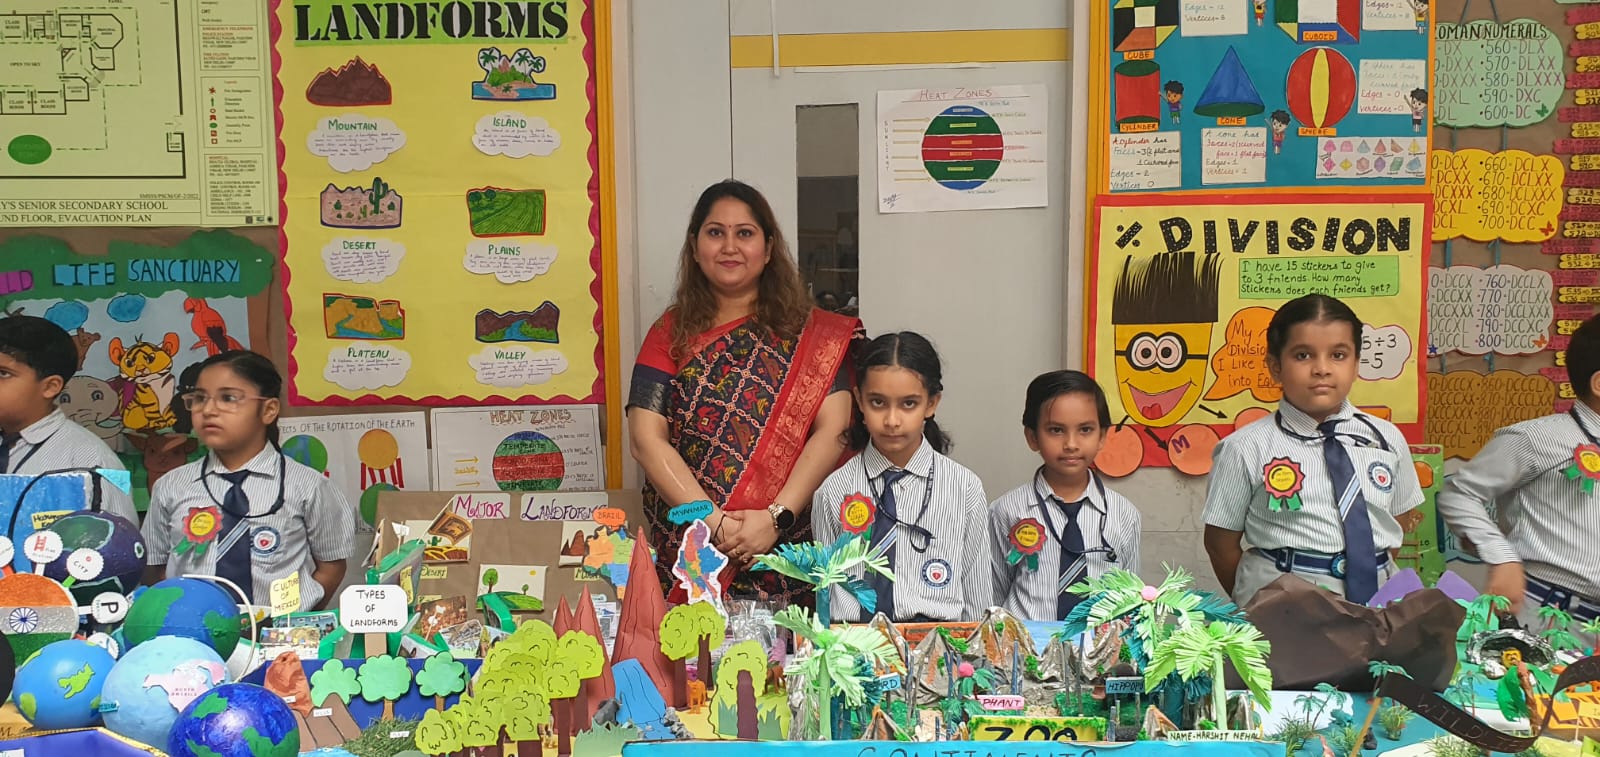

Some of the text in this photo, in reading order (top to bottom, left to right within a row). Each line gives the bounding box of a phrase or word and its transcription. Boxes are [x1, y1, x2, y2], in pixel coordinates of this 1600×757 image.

[294, 0, 568, 41] LANDFORMS
[1484, 23, 1548, 40] NUMERALS
[1127, 52, 1151, 60] CUBE
[328, 119, 378, 131] MOUNTAIN
[493, 117, 527, 129] ISLAND
[19, 201, 57, 211] SENIOR
[59, 201, 123, 211] SECONDARY
[127, 201, 169, 211] SCHOOL
[58, 214, 126, 223] EVACUATION
[126, 214, 152, 223] PLAN
[1159, 216, 1412, 256] DIVISION
[342, 240, 378, 250] DESERT
[488, 244, 521, 256] PLAINS
[52, 262, 116, 287] LIFE
[128, 258, 240, 284] SANCTUARY
[1242, 260, 1376, 275] I have 15 stickers to give
[1242, 275, 1252, 284] to
[1254, 273, 1264, 284] 3
[1312, 274, 1329, 282] How
[1333, 274, 1361, 286] many
[1285, 285, 1306, 295] does
[1333, 283, 1367, 296] friends
[1370, 283, 1392, 296] get?
[1231, 321, 1253, 345] My
[347, 347, 390, 359] PLATEAU
[494, 351, 527, 360] VALLEY
[1217, 358, 1226, 371] I
[489, 409, 573, 426] HEAT ZONES
[299, 423, 312, 433] OF
[312, 423, 327, 432] THE
[327, 421, 366, 434] ROTATION
[391, 419, 416, 429] EARTH
[1171, 434, 1191, 454] M
[597, 511, 623, 520] BRAZIL
[672, 503, 710, 518] MYANMAR
[356, 589, 386, 600] TYPES
[364, 603, 377, 613] OF
[349, 618, 398, 629] LANDFORMS
